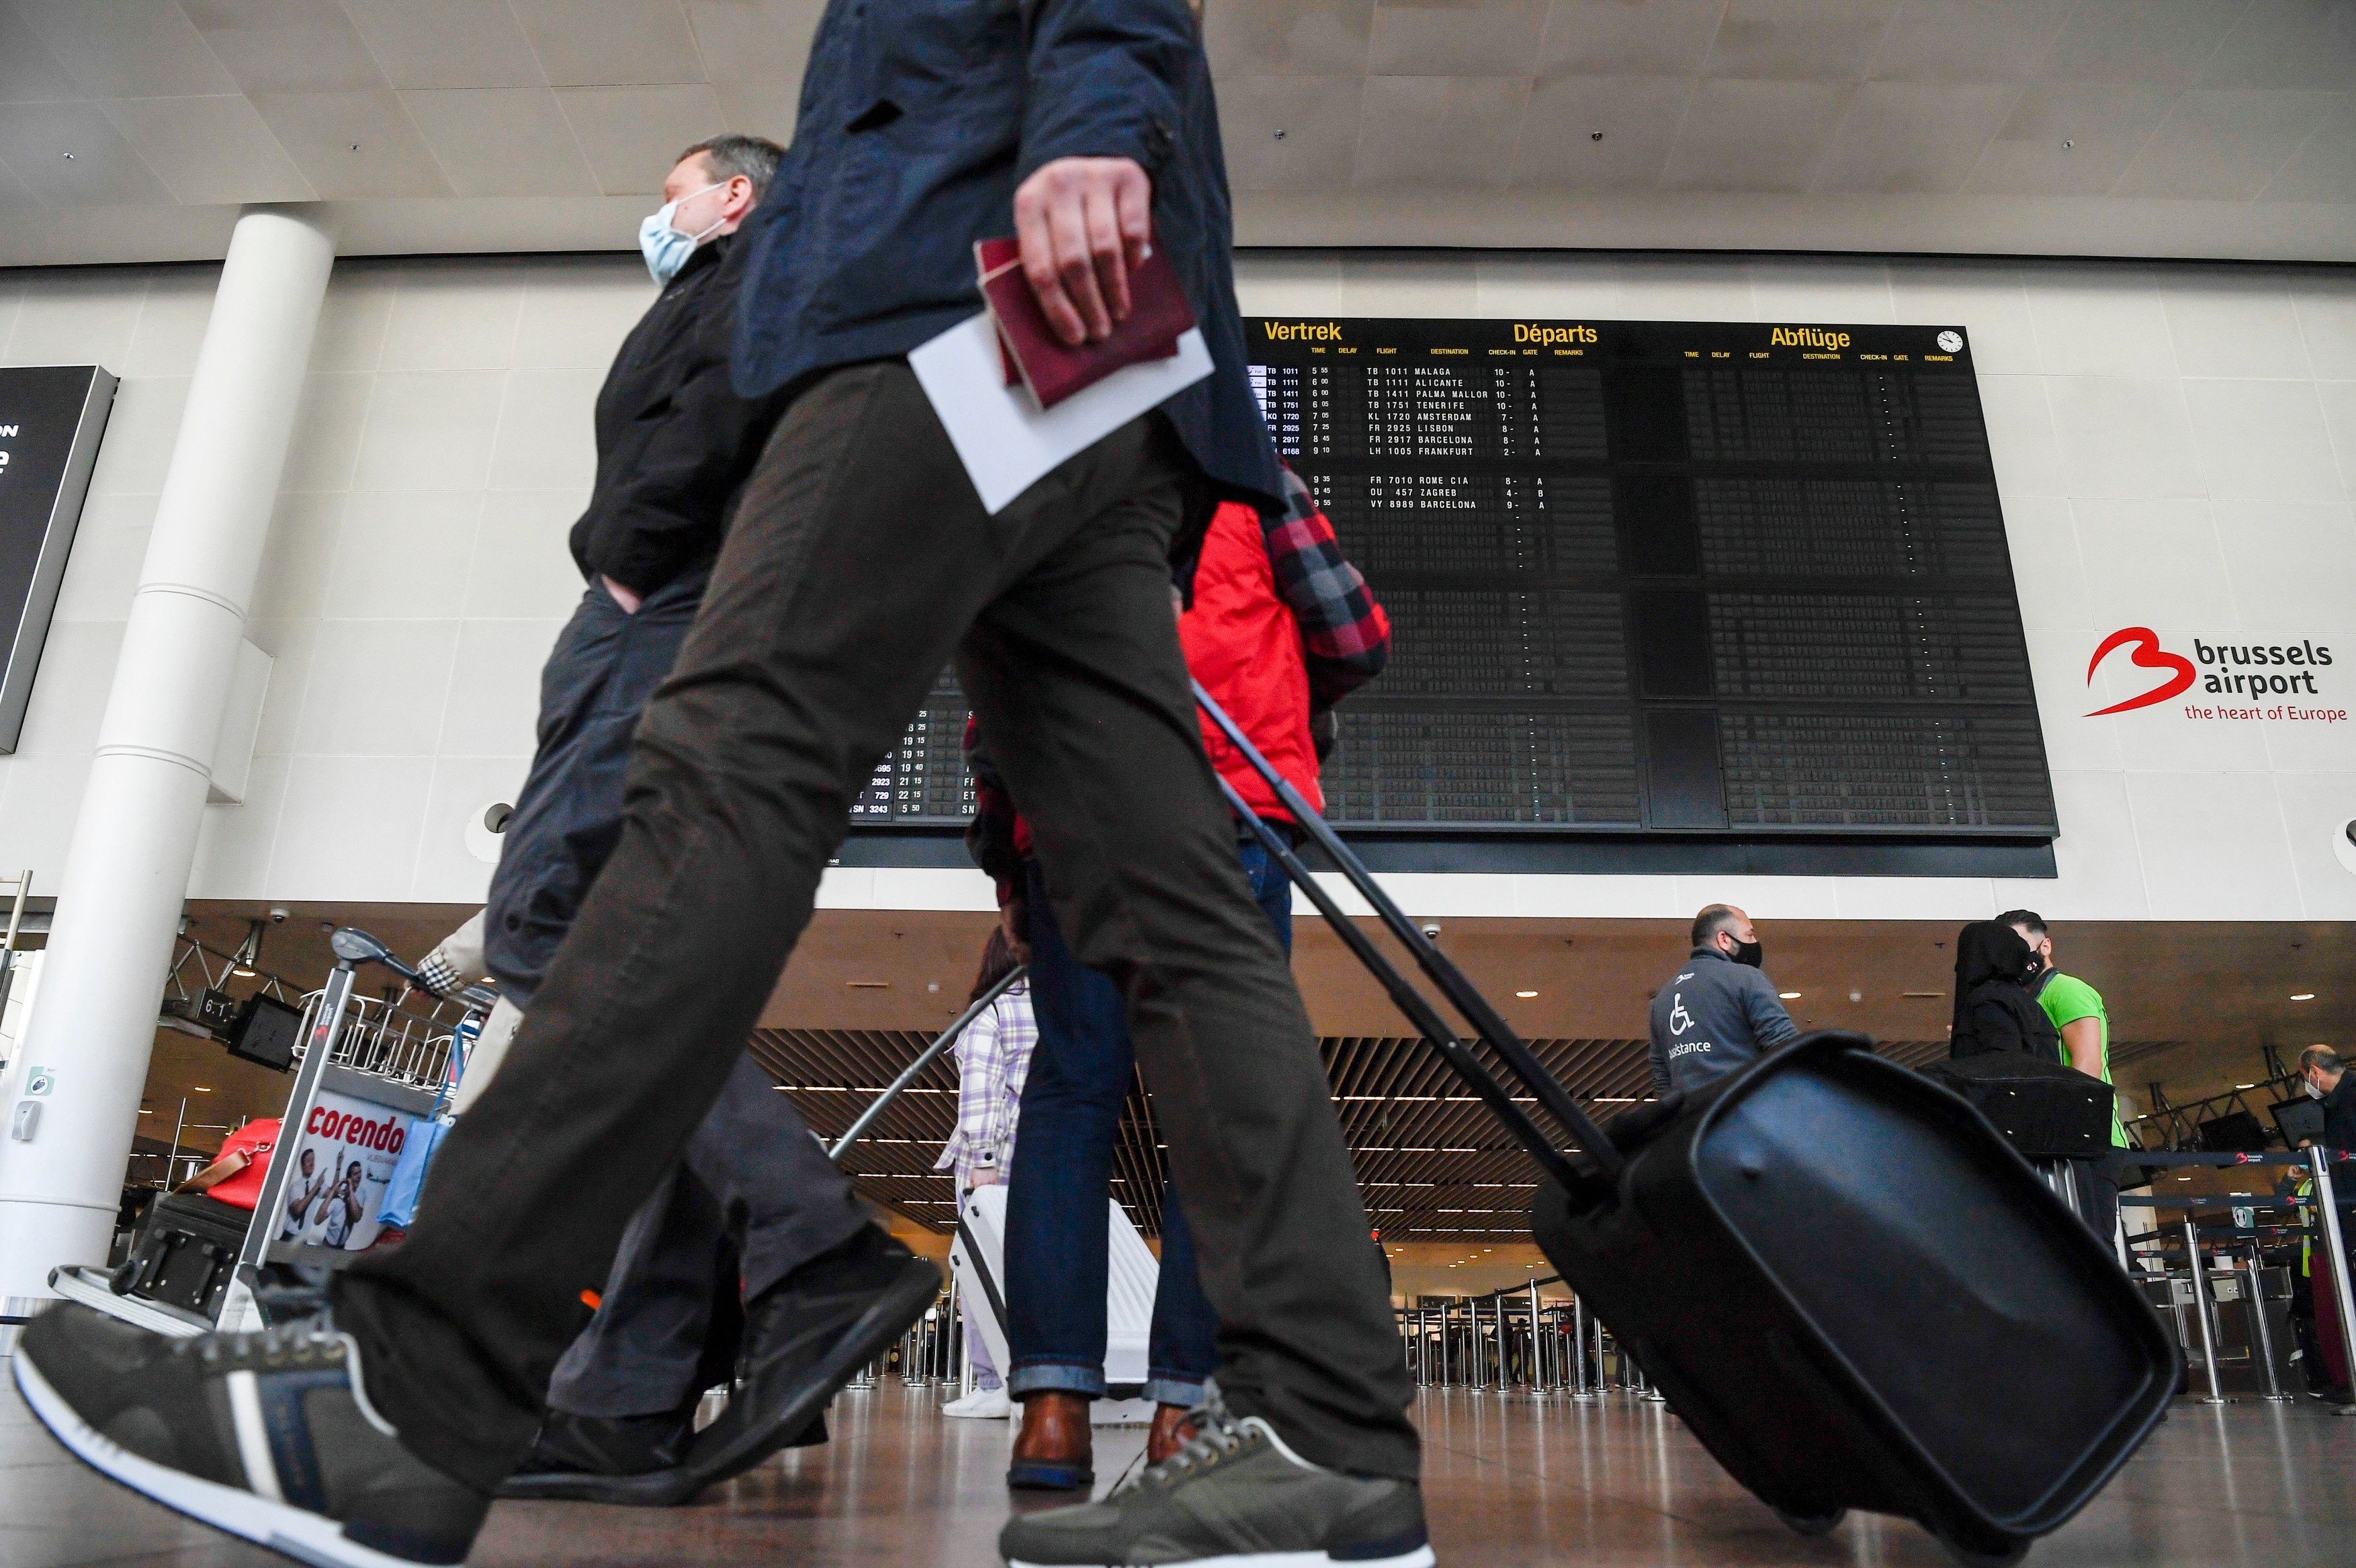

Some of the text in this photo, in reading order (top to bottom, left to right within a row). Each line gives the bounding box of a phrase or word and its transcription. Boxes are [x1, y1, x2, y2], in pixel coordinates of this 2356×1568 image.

[1264, 322, 1342, 341] Vertrek
[1514, 324, 1598, 347] Départs
[1771, 327, 1850, 351] Abflüge
[1385, 367, 1407, 376] 1011
[1414, 367, 1450, 376] MALAGA
[1367, 378, 1379, 386] TB
[1415, 379, 1463, 387] ALICANTE
[1367, 390, 1379, 398] TB
[1386, 390, 1408, 398] 1411
[1452, 390, 1488, 398] MALLOR
[1368, 401, 1379, 409] TB
[1386, 401, 1409, 409] 1751
[1416, 401, 1465, 410] TENERIFE
[1368, 412, 1380, 421] KL
[1387, 412, 1410, 421] 1720
[1417, 412, 1472, 421] AMSTERDAM
[1368, 424, 1380, 432] FR
[1387, 424, 1411, 432] 2925
[1417, 424, 1454, 433] LISBON
[1369, 435, 1381, 443] FR
[1387, 435, 1411, 443] 2917
[1418, 435, 1473, 444] BARCELONA
[1369, 447, 1381, 455] LH
[1388, 447, 1411, 455] 1005
[1418, 447, 1473, 455] FRANKFURT
[1370, 476, 1381, 484] FR
[1389, 476, 1413, 484] 7010
[1419, 476, 1444, 484] ROME
[1450, 476, 1469, 484] CIA
[1370, 488, 1382, 496] OU
[1395, 488, 1413, 496] 457
[1420, 488, 1456, 496] ZAGREB
[1370, 500, 1383, 508] VY
[1389, 500, 1413, 509] 8989
[1420, 500, 1476, 509] BARCELONA
[2193, 638, 2332, 666] brussels
[2204, 666, 2318, 700] airport
[2185, 705, 2347, 724] the heart of Europe
[903, 736, 913, 746] 19
[902, 750, 912, 759] 19
[873, 764, 891, 773] 695
[901, 763, 911, 772] 19
[871, 777, 890, 786] 2923
[899, 777, 909, 786] 21
[875, 791, 889, 800] 729
[898, 790, 909, 799] 22
[853, 805, 865, 814] SN
[869, 805, 888, 814] 3243
[902, 804, 908, 813] 5
